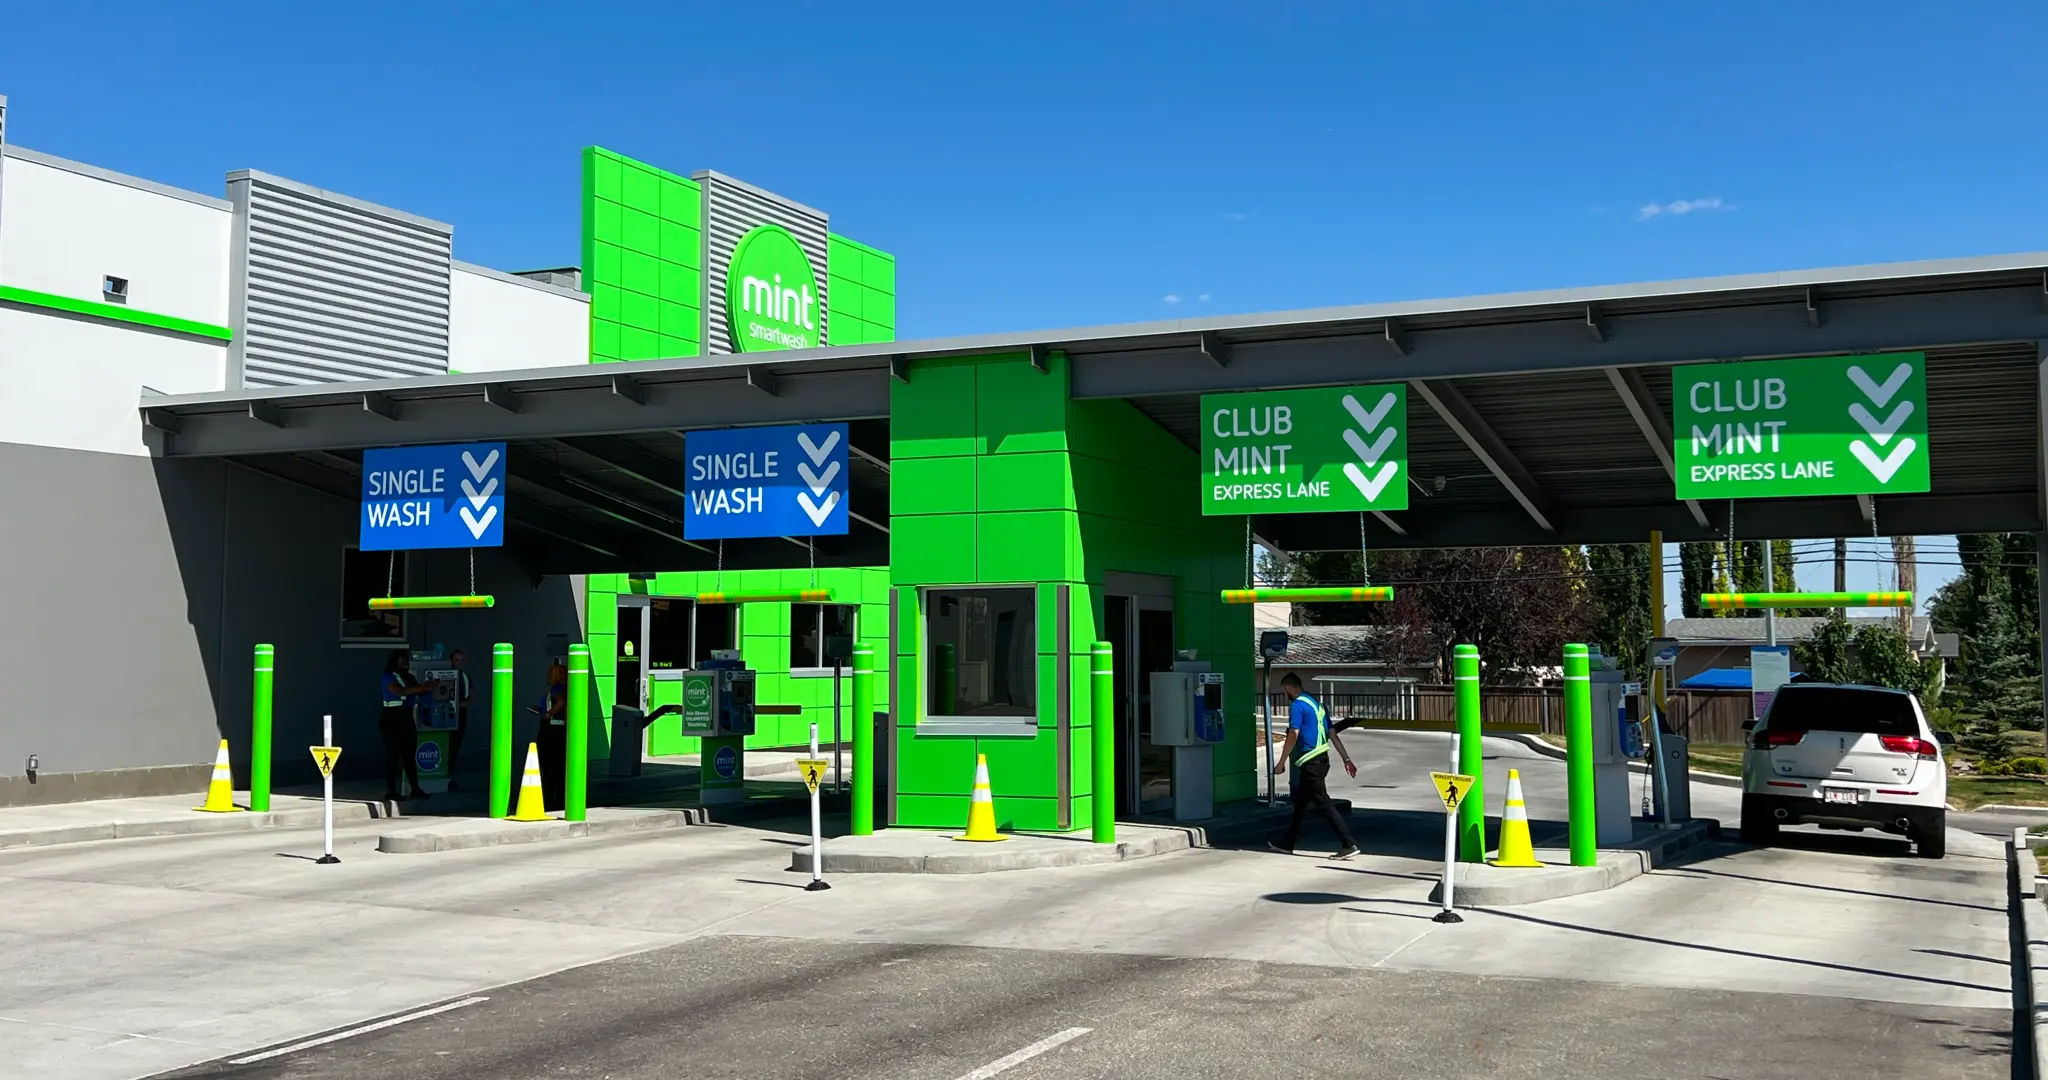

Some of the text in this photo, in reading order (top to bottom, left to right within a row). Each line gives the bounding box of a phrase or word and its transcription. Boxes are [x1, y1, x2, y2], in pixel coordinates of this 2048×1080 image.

[743, 273, 814, 331] mint
[749, 322, 807, 348] smartwash
[1690, 378, 1787, 413] CLUB
[1213, 406, 1293, 438] CLUB
[1691, 421, 1787, 456] MINT
[692, 451, 778, 481] SINGLE
[1214, 444, 1293, 477] MINT
[1691, 461, 1835, 483] EXPRESS LANE
[368, 468, 445, 496] SINGLE
[1213, 481, 1331, 500] EXPRESS LANE
[367, 501, 431, 528] WASH
[691, 486, 763, 515] WASH
[687, 687, 706, 696] mint
[418, 750, 438, 760] mint
[717, 756, 735, 765] mint
